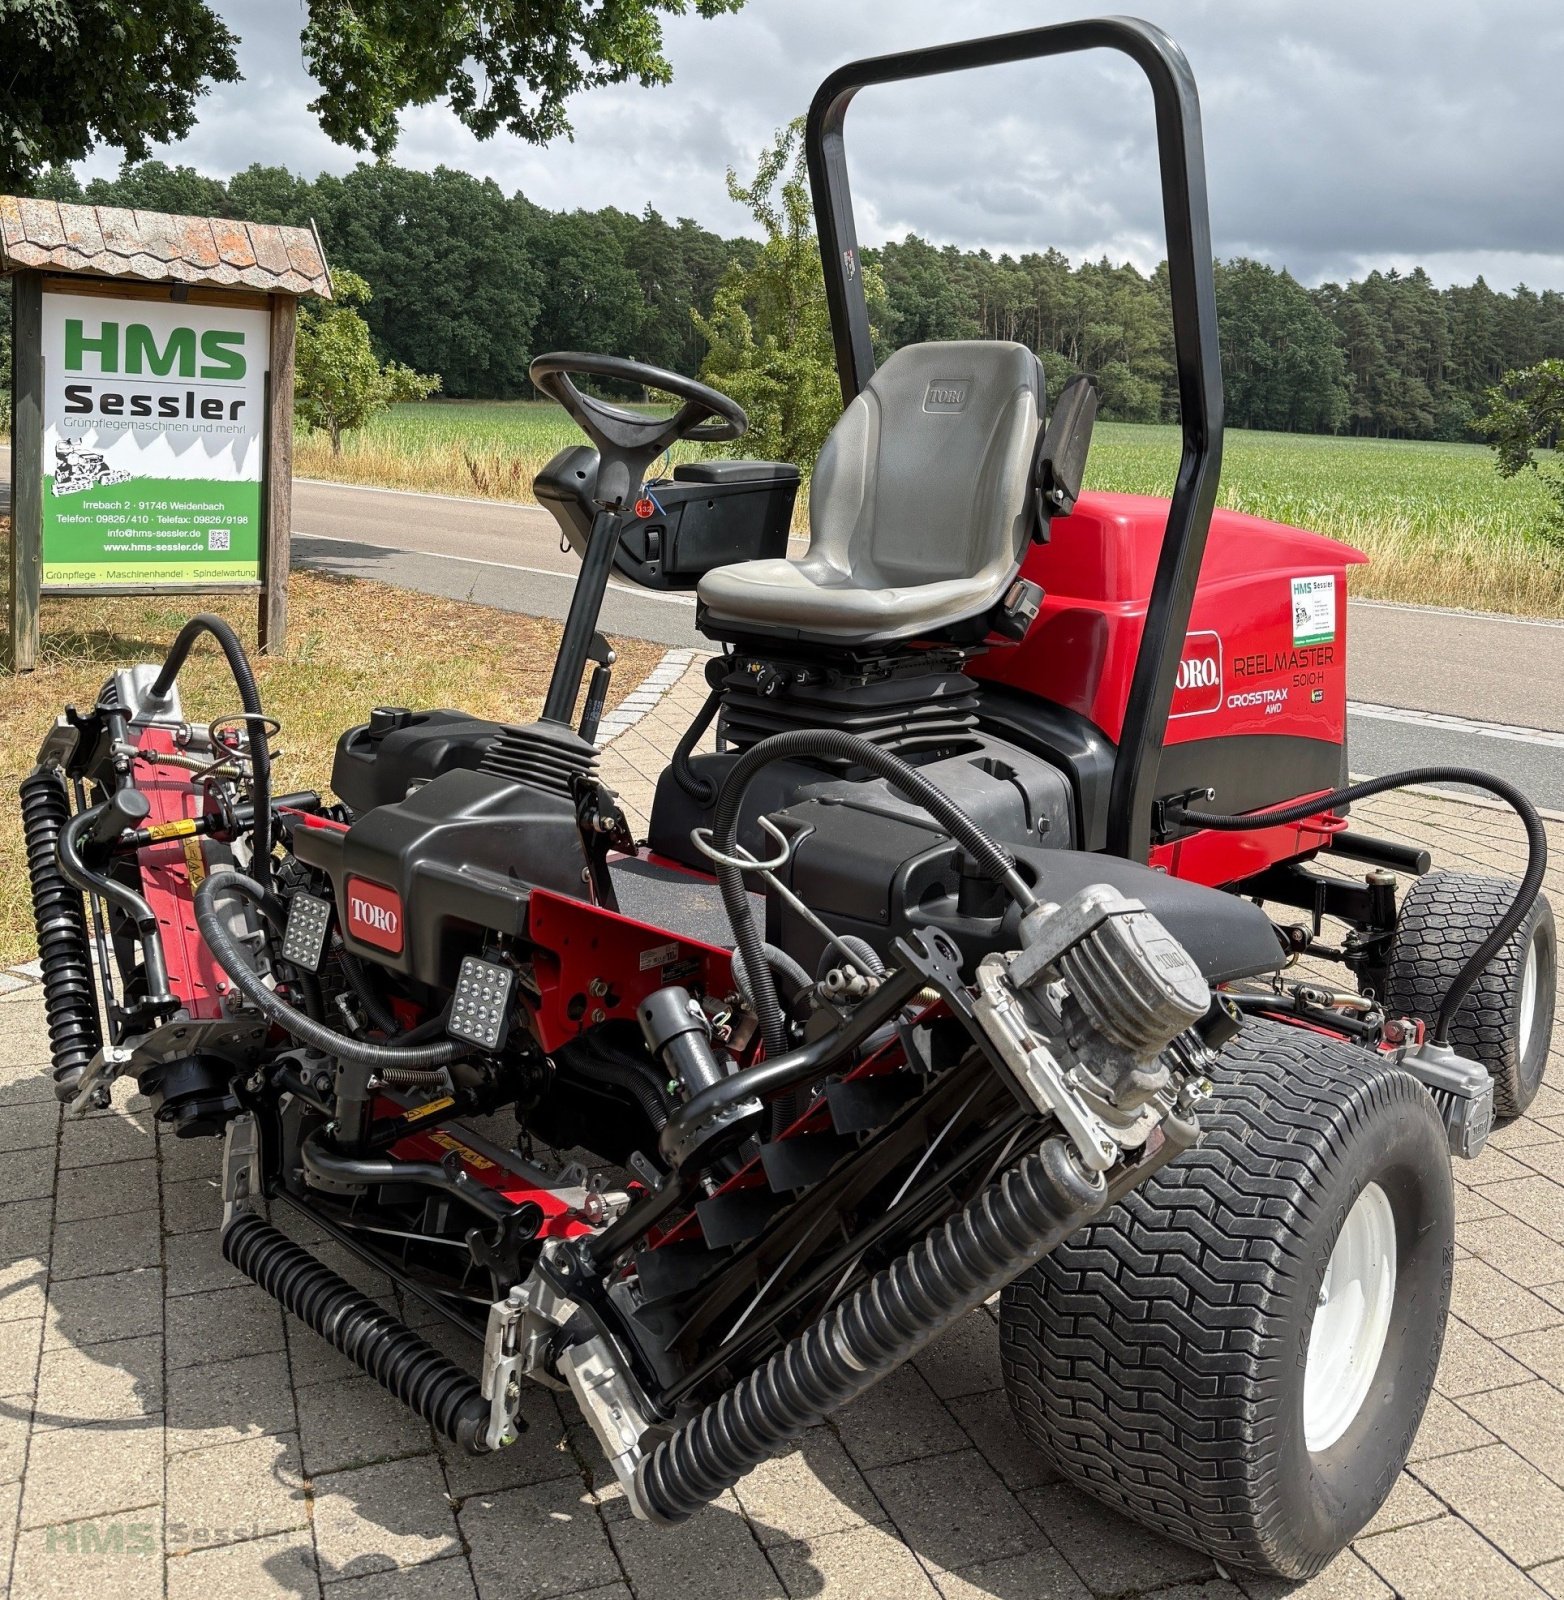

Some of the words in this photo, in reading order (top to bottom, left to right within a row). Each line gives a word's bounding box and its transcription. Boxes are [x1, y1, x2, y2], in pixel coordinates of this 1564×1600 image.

[65, 319, 247, 380] HMS
[64, 384, 246, 421] Sessler
[930, 389, 966, 403] TORO
[63, 416, 189, 432] Grünpflegemaschinen
[192, 423, 213, 433] und
[215, 424, 246, 434] mehr!
[83, 500, 122, 510] Irrebach
[124, 501, 131, 510] 2
[138, 502, 168, 510] 91746
[170, 502, 225, 511] Weidenbach
[56, 514, 94, 523] Telefon:
[96, 515, 149, 524] 09826/410
[156, 516, 191, 524] Telefax:
[193, 516, 249, 525] 09826/9198
[107, 529, 201, 538] info@hms-sessler.de
[103, 543, 204, 551] www.hms-sessler.de
[45, 570, 96, 581] Grünpflege
[106, 569, 184, 579] Maschinenhandel
[193, 569, 256, 578] Spindelwartung
[1293, 582, 1313, 595] HMS
[1233, 646, 1334, 678] REELMASTER
[1175, 657, 1218, 690] ORO
[1227, 688, 1288, 708] CROSSTRAX
[1264, 703, 1282, 715] AWD
[351, 897, 398, 934] TORO
